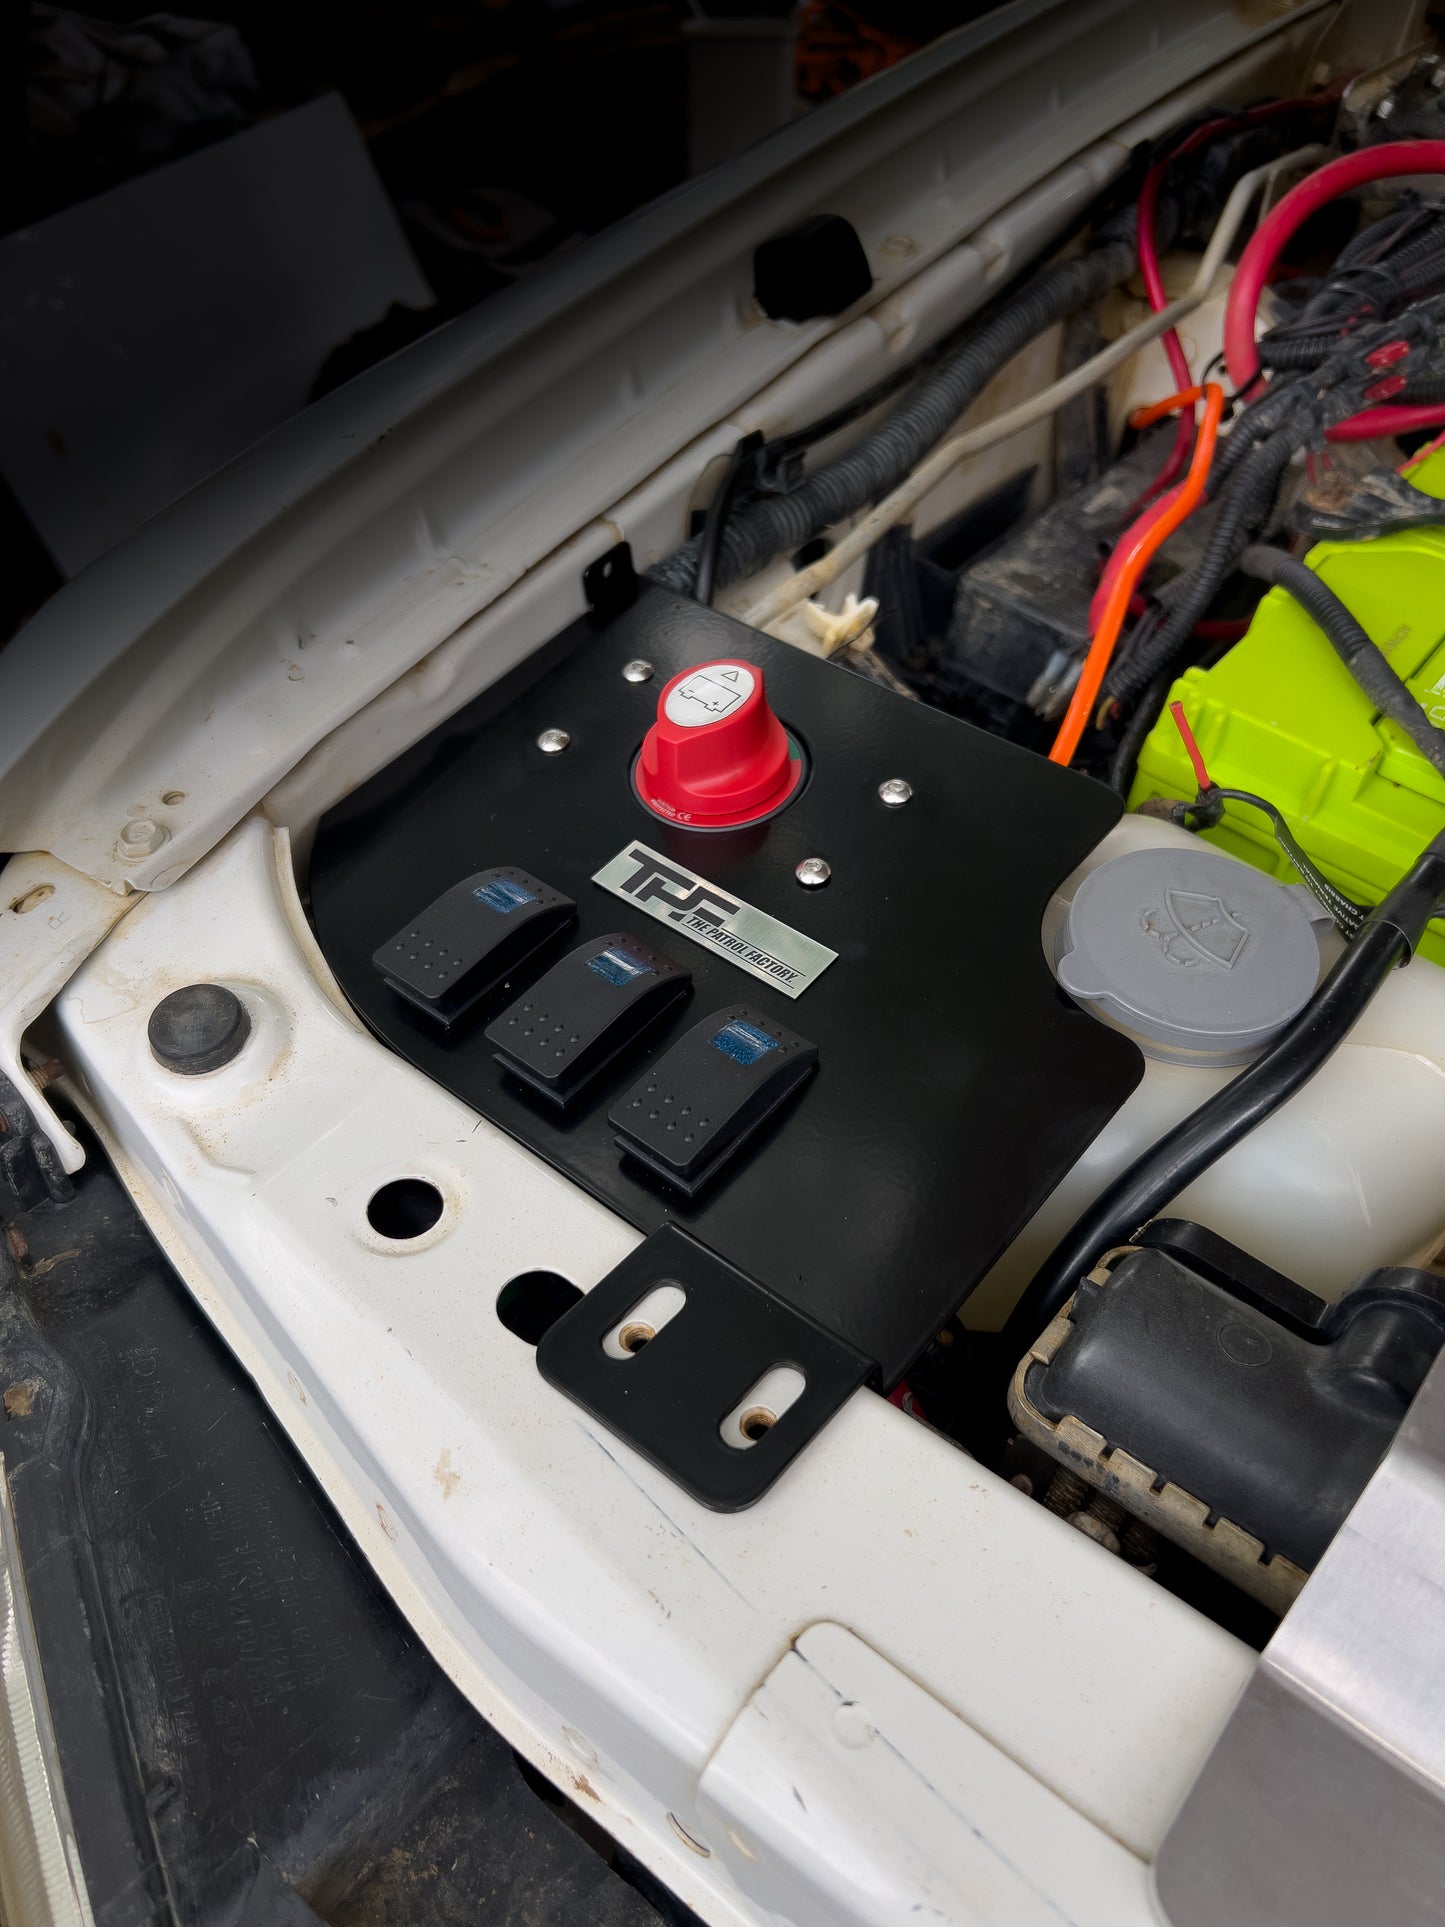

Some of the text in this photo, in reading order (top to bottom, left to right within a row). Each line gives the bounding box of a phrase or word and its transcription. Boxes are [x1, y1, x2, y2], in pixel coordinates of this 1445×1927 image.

[1323, 883, 1358, 916] CHASSIS
[686, 916, 710, 933] THE
[706, 927, 749, 955] PATROL
